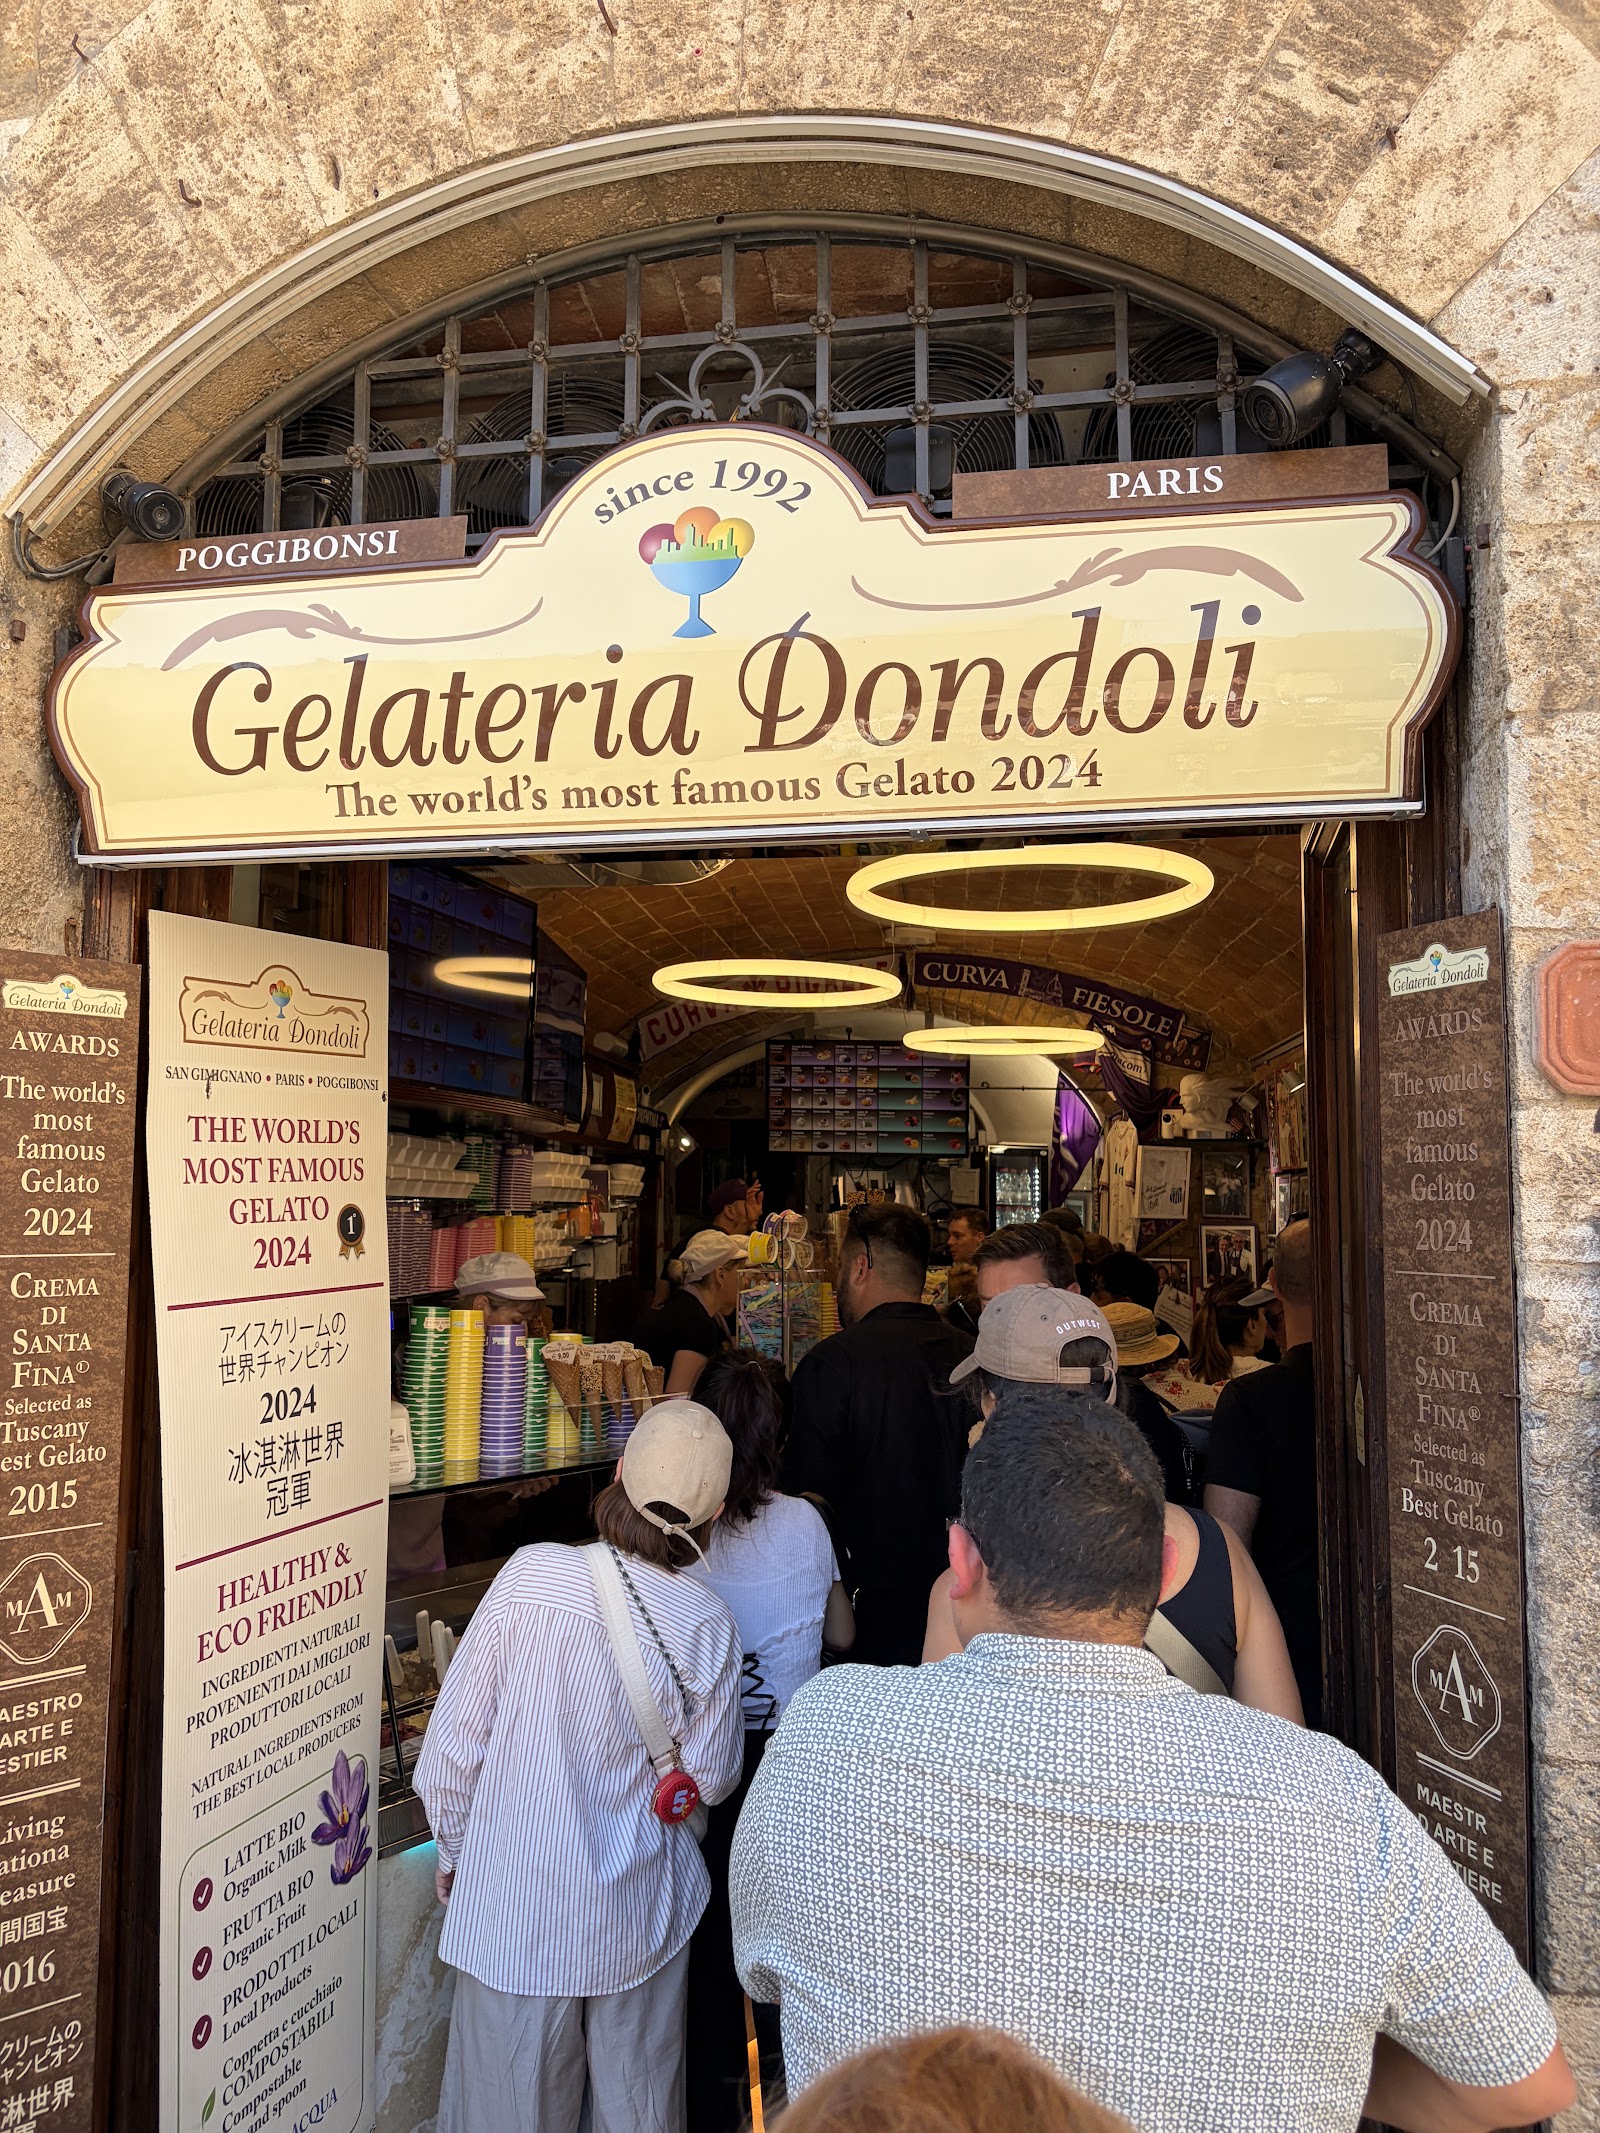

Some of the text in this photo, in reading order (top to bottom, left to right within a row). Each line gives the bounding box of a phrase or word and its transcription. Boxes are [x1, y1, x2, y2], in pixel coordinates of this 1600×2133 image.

[592, 458, 813, 525] since 1992
[1106, 465, 1224, 500] PARIS
[176, 530, 399, 573] POGGIBONSI
[192, 600, 1261, 776] Gelateria Dondoli
[325, 748, 1103, 819] The world's most famous Gelato 2024
[1393, 962, 1485, 993] Gelateria Dondoli
[9, 993, 122, 1016] Gelateria Dondoli
[922, 962, 1010, 990] CURVA
[1071, 987, 1173, 1036] FIESOLE
[191, 1008, 360, 1050] Gelateria Dondoli
[646, 1002, 731, 1046] CURV
[1395, 1008, 1482, 1042] AWARDS
[9, 1030, 120, 1057] AWARDS
[0, 1075, 126, 1105] The world's
[165, 1066, 379, 1092] SAN GIMIGNANO PARIS POGGIBONSI
[1389, 1064, 1492, 1098] The world's
[33, 1110, 94, 1132] most
[187, 1115, 361, 1144] THE WORLD'S
[1417, 1107, 1465, 1128] most
[16, 1135, 106, 1162] famous
[1405, 1137, 1478, 1164] famous
[20, 1168, 100, 1194] Gelato
[182, 1157, 364, 1184] MOST FAMOUS
[1411, 1174, 1475, 1201] Gelato
[23, 1207, 94, 1236] 2024
[229, 1195, 329, 1225] GELATO
[253, 1235, 312, 1270] 2024
[1415, 1219, 1473, 1252] 2024
[10, 1272, 100, 1299] CREMA
[41, 1306, 67, 1326] DI
[1056, 1319, 1100, 1334] OUTWEST
[1410, 1291, 1484, 1327] CREMA
[12, 1328, 93, 1356] SANTA
[219, 1312, 347, 1353] アイスクリームの
[1435, 1335, 1457, 1358] DI
[218, 1340, 350, 1386] 世界チャンピオン
[1415, 1356, 1482, 1394] SANTA
[5, 1394, 92, 1416] Selected as
[260, 1384, 317, 1425] 2024
[0, 1420, 90, 1444] Tuscany
[1414, 1434, 1486, 1466] Selected as
[0, 1443, 107, 1472] est Gelato
[227, 1421, 345, 1485] 冰淇淋世界
[8, 1479, 78, 1517] 2015
[265, 1470, 312, 1520] 冠軍
[1410, 1458, 1485, 1507] Tuscany
[1401, 1487, 1504, 1538] Best Gelato
[217, 1542, 353, 1614] HEALTHY &
[197, 1569, 367, 1664] ECO FRIENDLY
[201, 1613, 361, 1700] INGREDIENTI NATURALI
[186, 1632, 371, 1735] PROVENIENTI DAI MIGLIORI
[0, 1692, 83, 1724] AESTRO
[210, 1665, 352, 1750] PRODUTTORI LOCALI
[0, 1719, 73, 1750] ARTE E
[191, 1693, 364, 1798] NATURAL INGREDIENTS FROM
[0, 1745, 68, 1776] ESTIER
[193, 1715, 361, 1820] THE BEST LOCAL PRODUCERS
[671, 1789, 689, 1815] 5
[0, 1844, 71, 1877] ationa
[223, 1811, 305, 1877] LATTE BIO
[1483, 1847, 1494, 1870] E
[0, 1872, 76, 1907] easure
[223, 1840, 307, 1902] Organic Milk
[1452, 1860, 1503, 1904] TIERE
[0, 1905, 69, 1948] 間国宝
[222, 1870, 314, 1947] FRUTTA BIO
[222, 1903, 307, 1972] Organic Fruit
[0, 1948, 56, 1994] 016
[222, 1899, 358, 2017] PRODOTTI LOCALI
[222, 1965, 312, 2044] Local Products
[0, 2019, 82, 2065] クリームの
[222, 2026, 279, 2079] Coppetta
[290, 1974, 342, 2029] cucchiaio
[221, 2001, 335, 2107] COMPOSTABILI
[0, 2075, 76, 2131] 淋世界
[221, 2057, 302, 2133] Compostable
[247, 2077, 307, 2133] and spoon
